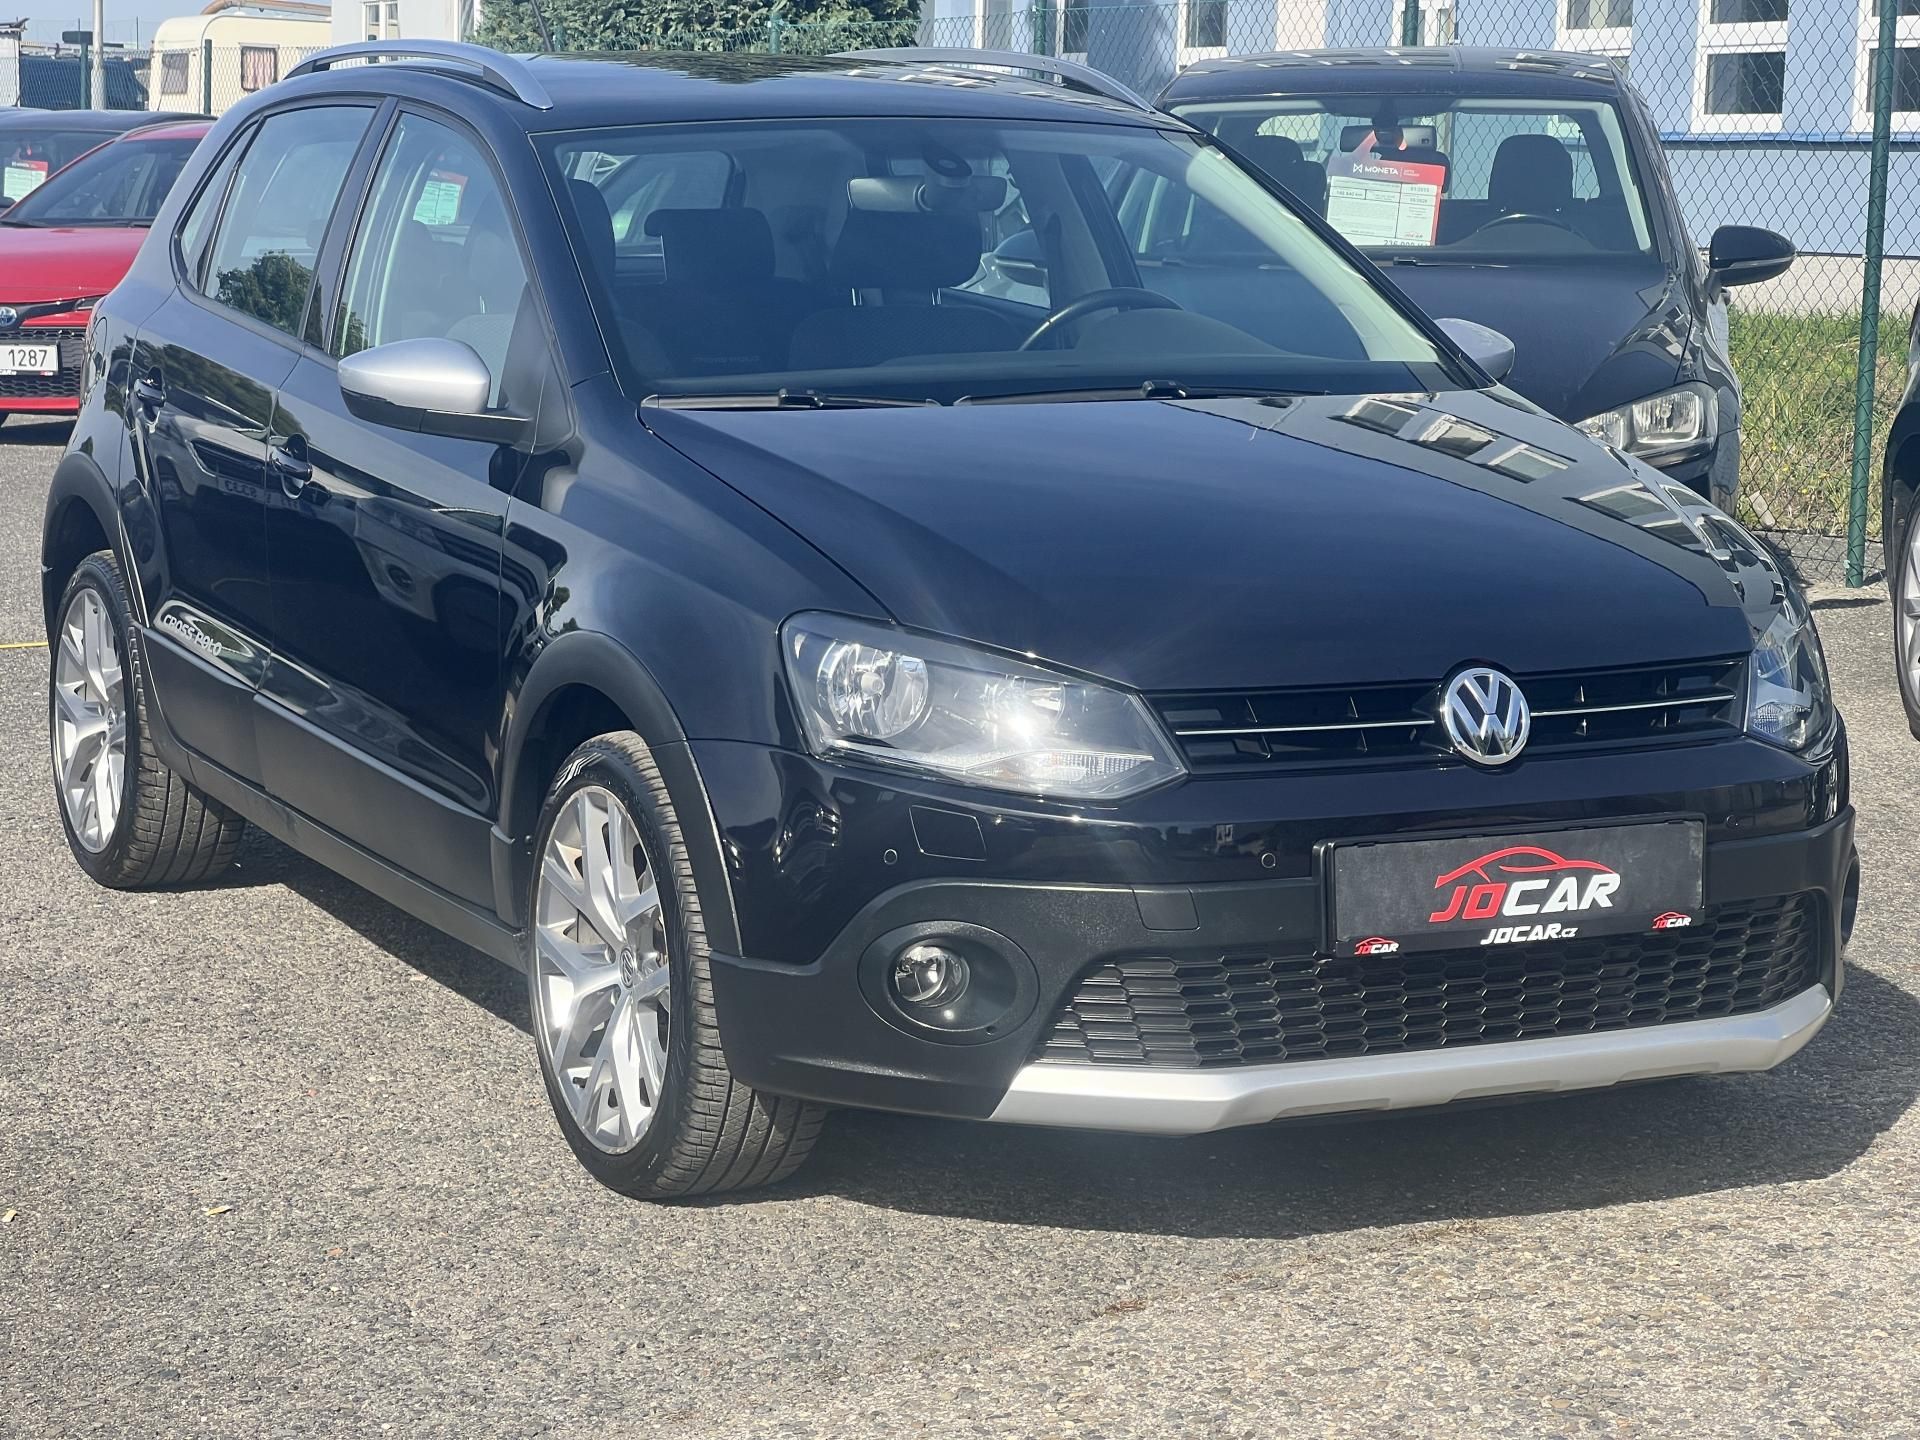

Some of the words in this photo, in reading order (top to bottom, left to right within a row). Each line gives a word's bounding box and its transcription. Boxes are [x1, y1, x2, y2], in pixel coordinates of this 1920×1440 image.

[1364, 166, 1399, 175] MONETA
[8, 349, 48, 367] 1287
[163, 614, 196, 641] CROSS
[194, 632, 222, 657] POLO
[1428, 872, 1621, 922] JOCAR
[1651, 917, 1692, 929] JOCAR
[1353, 942, 1400, 956] JOCAR
